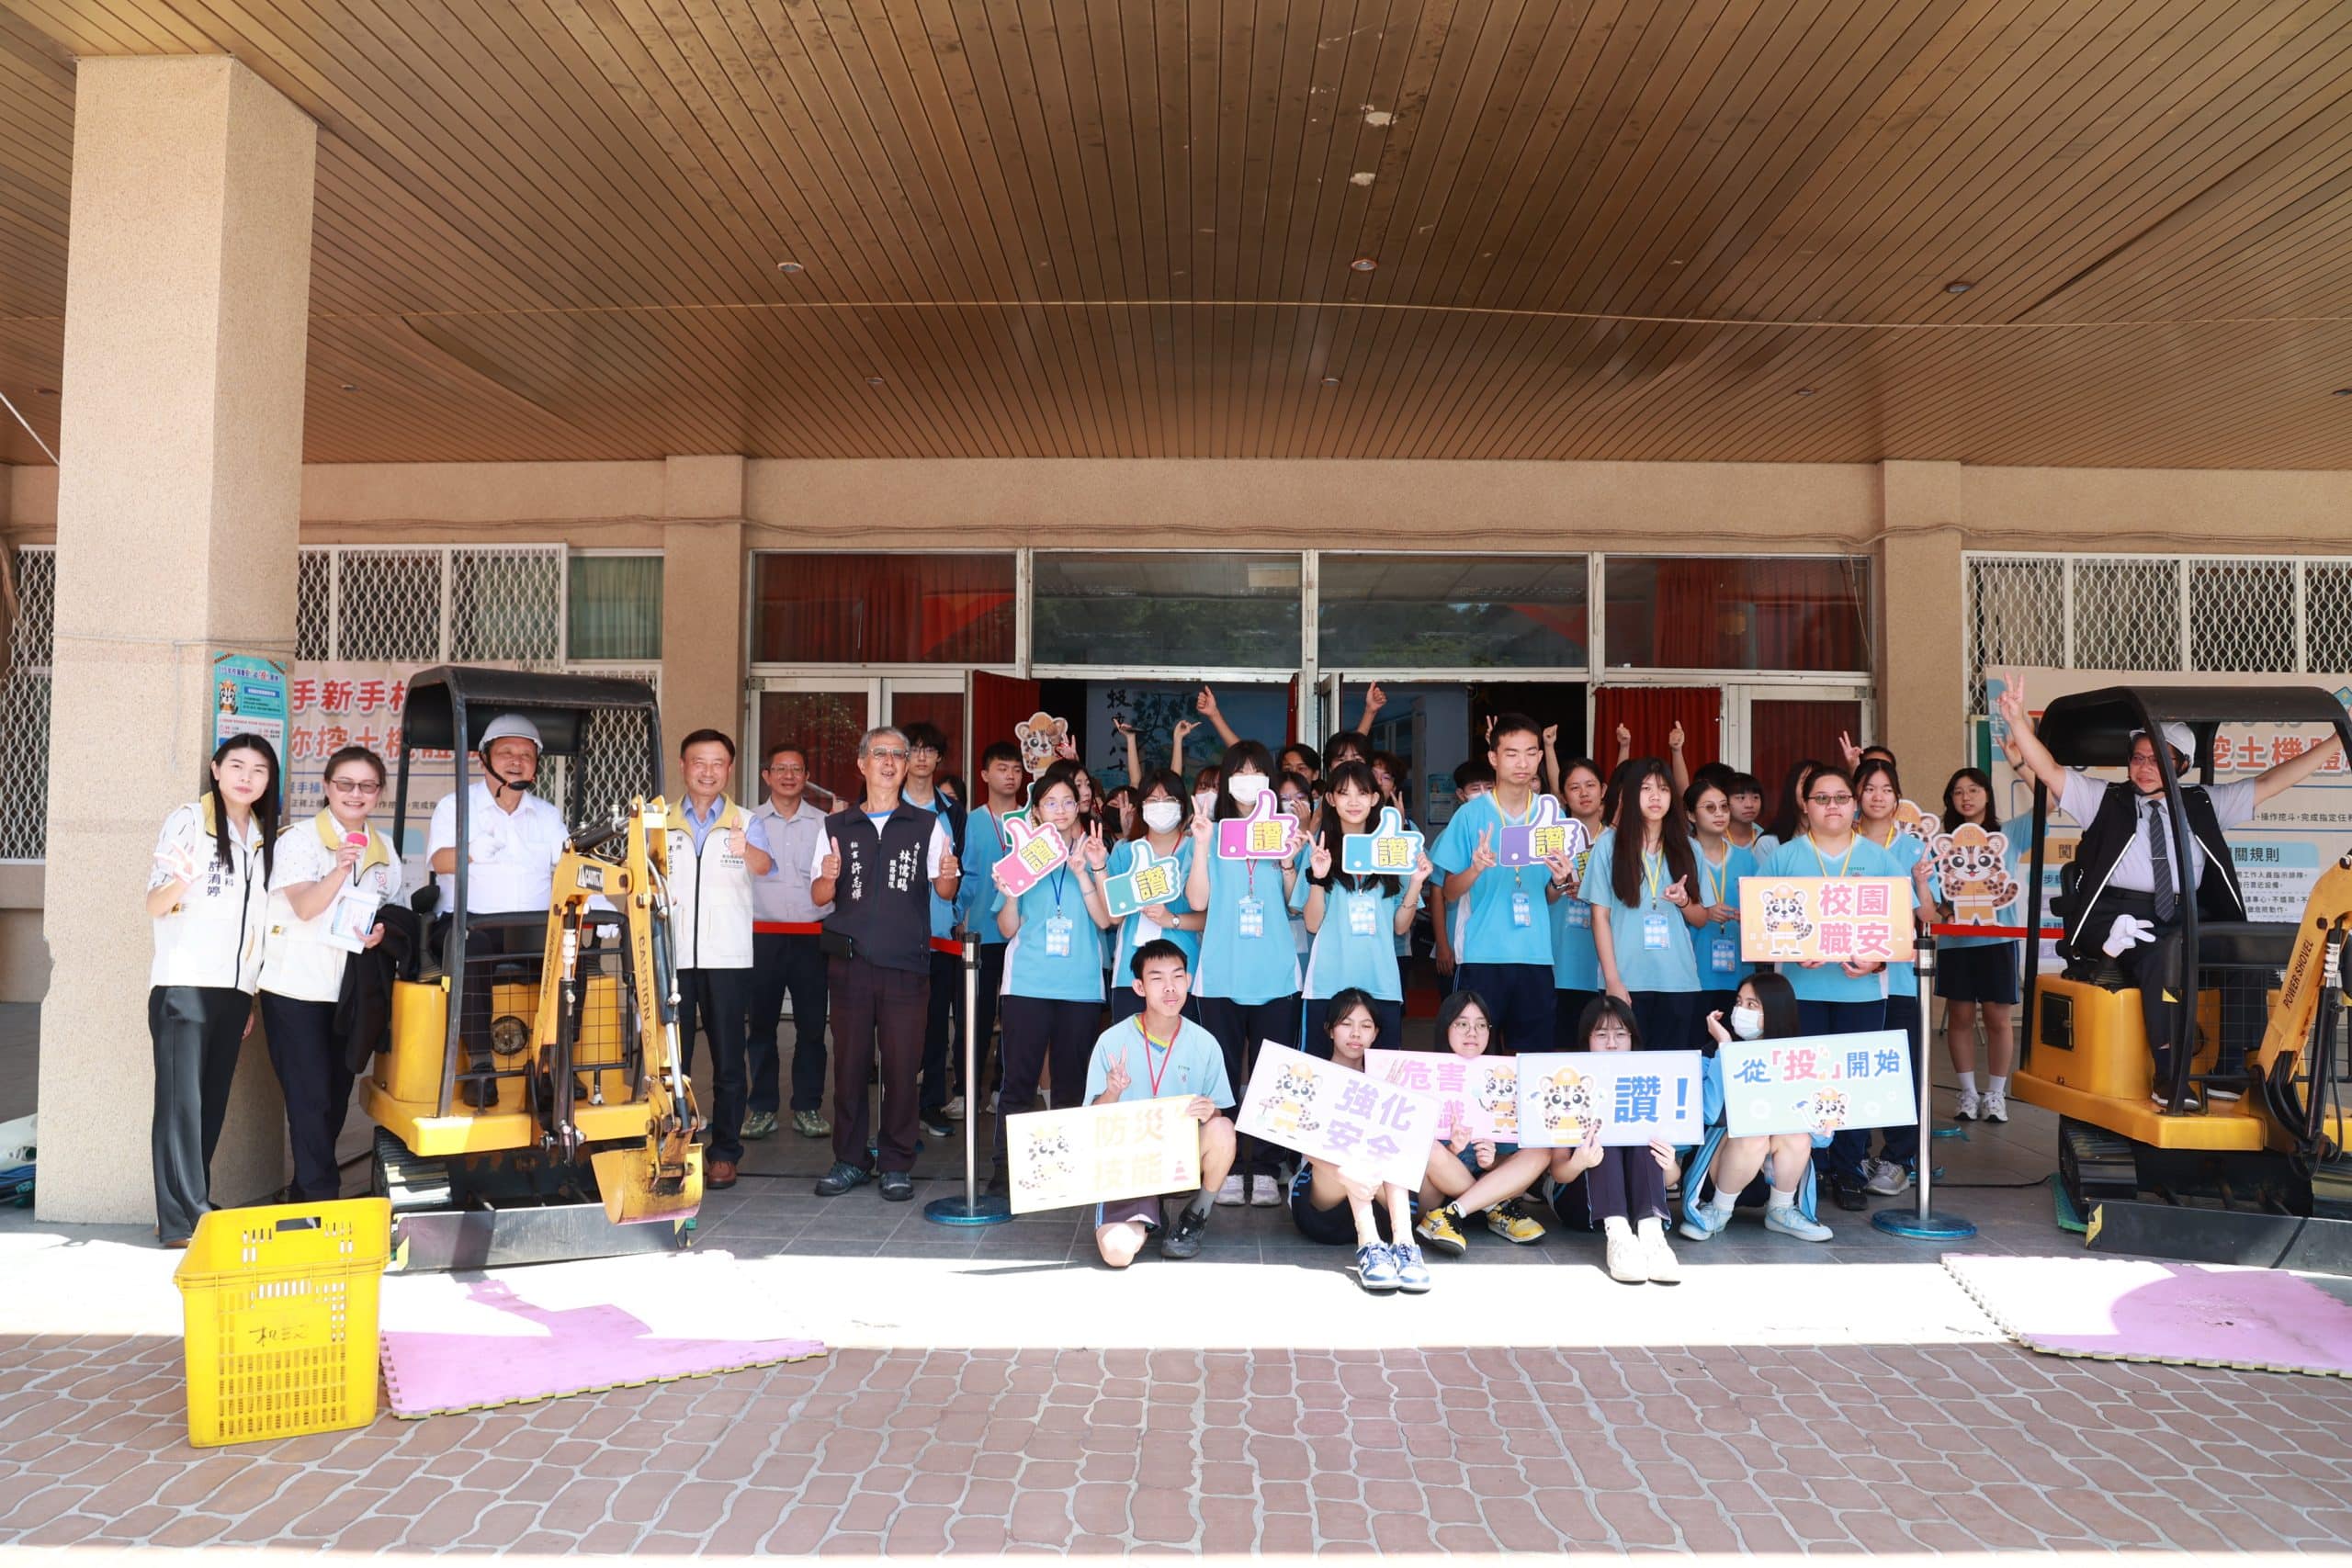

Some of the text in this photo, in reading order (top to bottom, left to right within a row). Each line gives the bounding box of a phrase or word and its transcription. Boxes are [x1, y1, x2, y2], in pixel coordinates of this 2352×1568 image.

[1819, 884, 1889, 917] 校園
[1818, 922, 1892, 957] 職安
[637, 935, 650, 1021] CAUTION
[2283, 939, 2313, 1010] POWER SHOVEL
[1401, 1059, 1467, 1093] 危害
[1733, 1048, 1901, 1084] 從「投」開始
[1334, 1077, 1417, 1132] 強化
[1322, 1118, 1401, 1163] 安全
